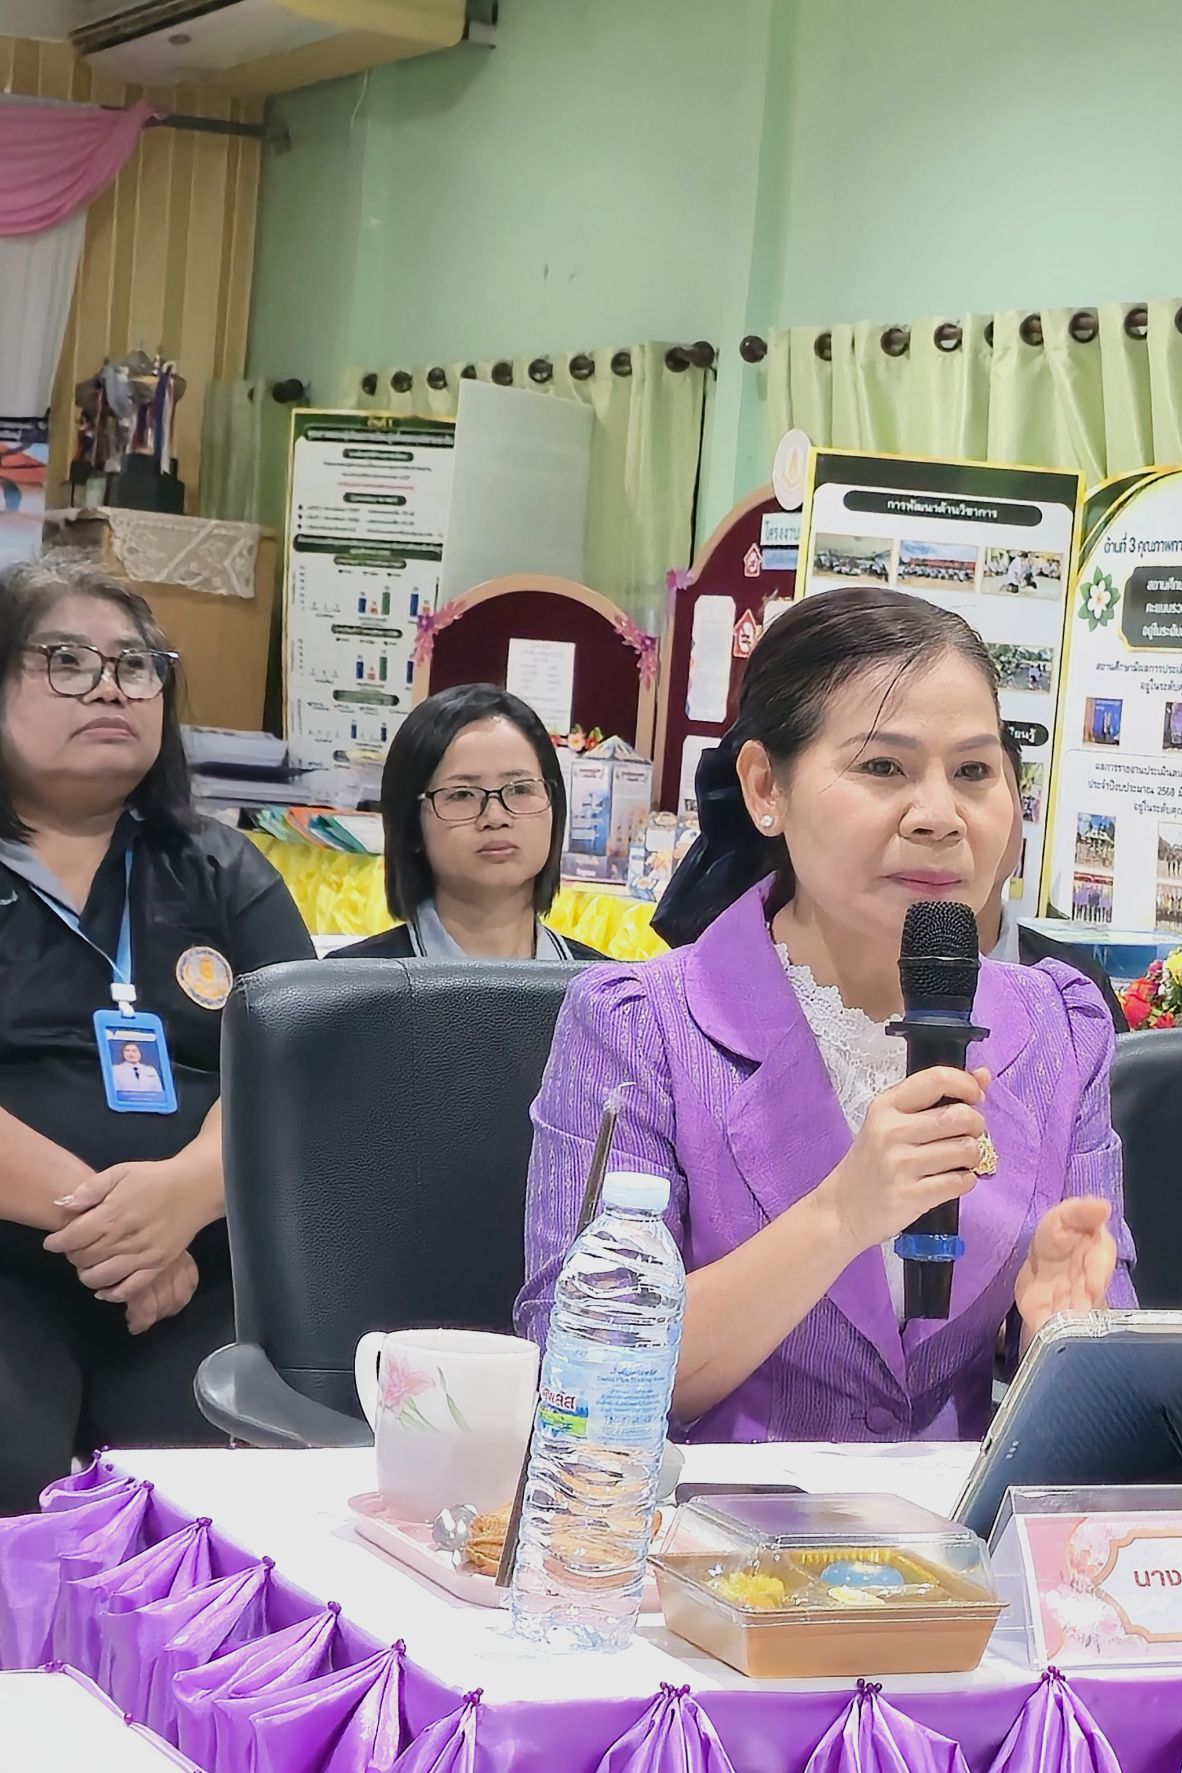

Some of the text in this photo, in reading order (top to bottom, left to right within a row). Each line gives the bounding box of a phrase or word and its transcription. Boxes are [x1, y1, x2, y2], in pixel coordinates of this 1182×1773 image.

[887, 496, 998, 518] การพัฒนาด้านวิชาการ
[1129, 537, 1136, 553] 3
